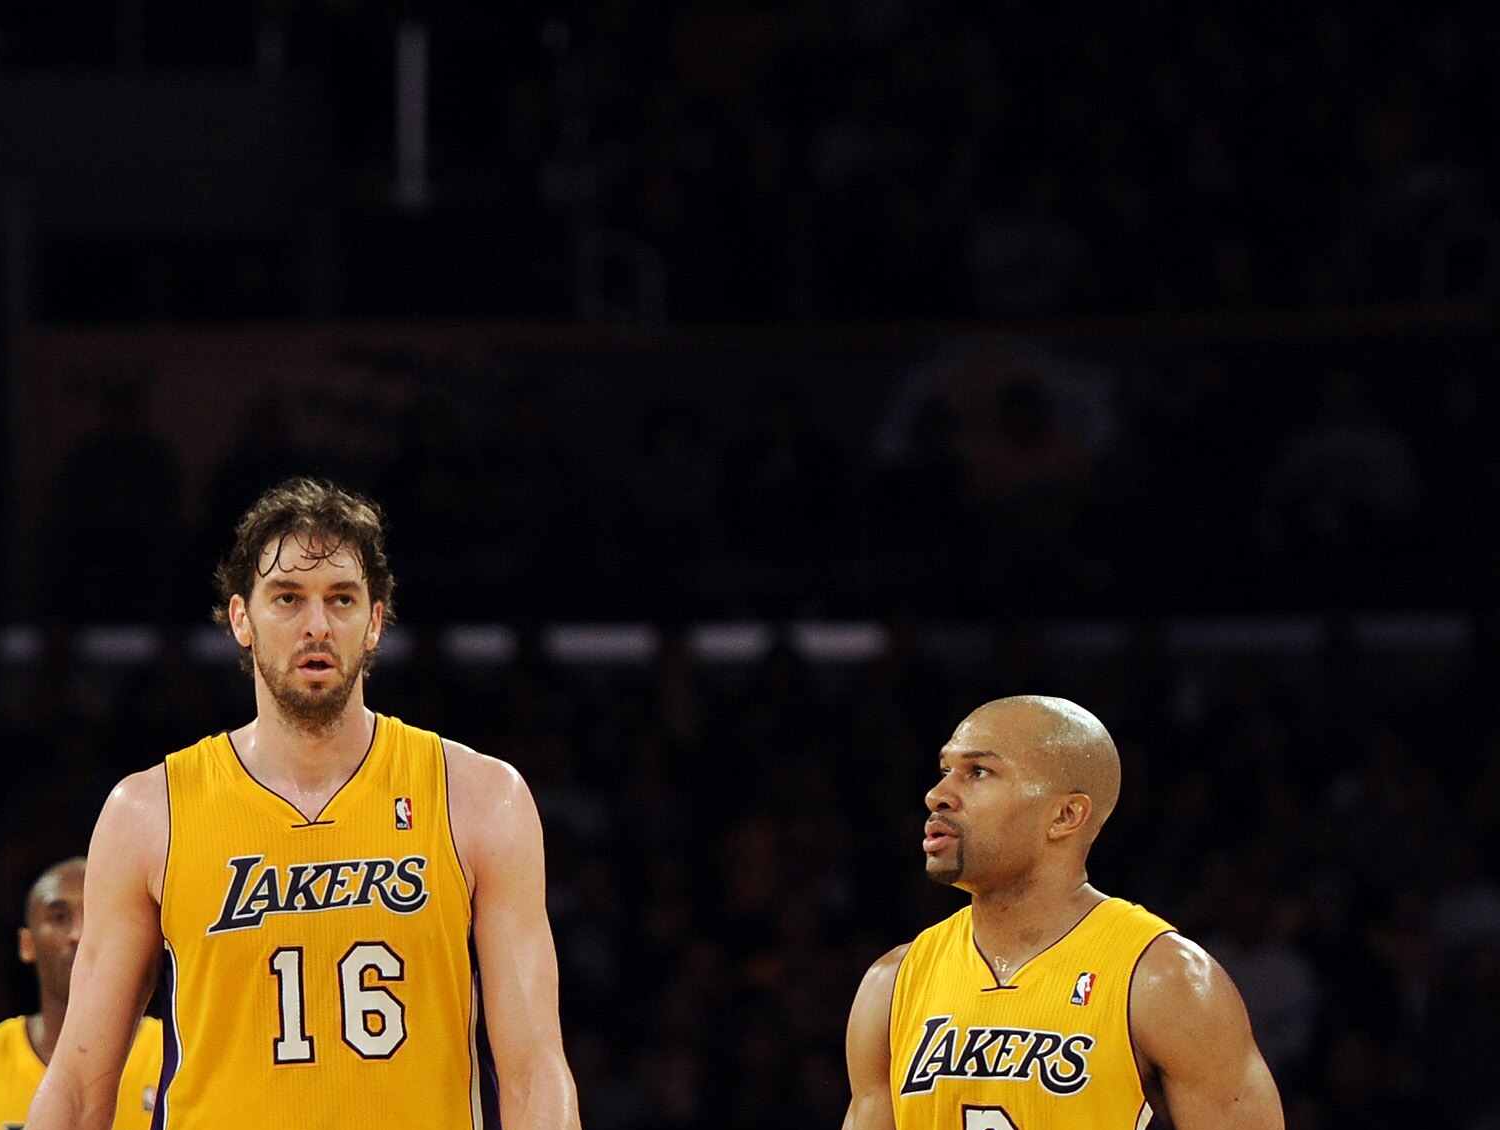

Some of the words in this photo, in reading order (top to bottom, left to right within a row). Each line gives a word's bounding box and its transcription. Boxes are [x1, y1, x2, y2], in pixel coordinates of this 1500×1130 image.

[206, 852, 431, 936] LAKERS
[269, 940, 408, 1066] 16
[900, 1014, 1095, 1097] LAKERS
